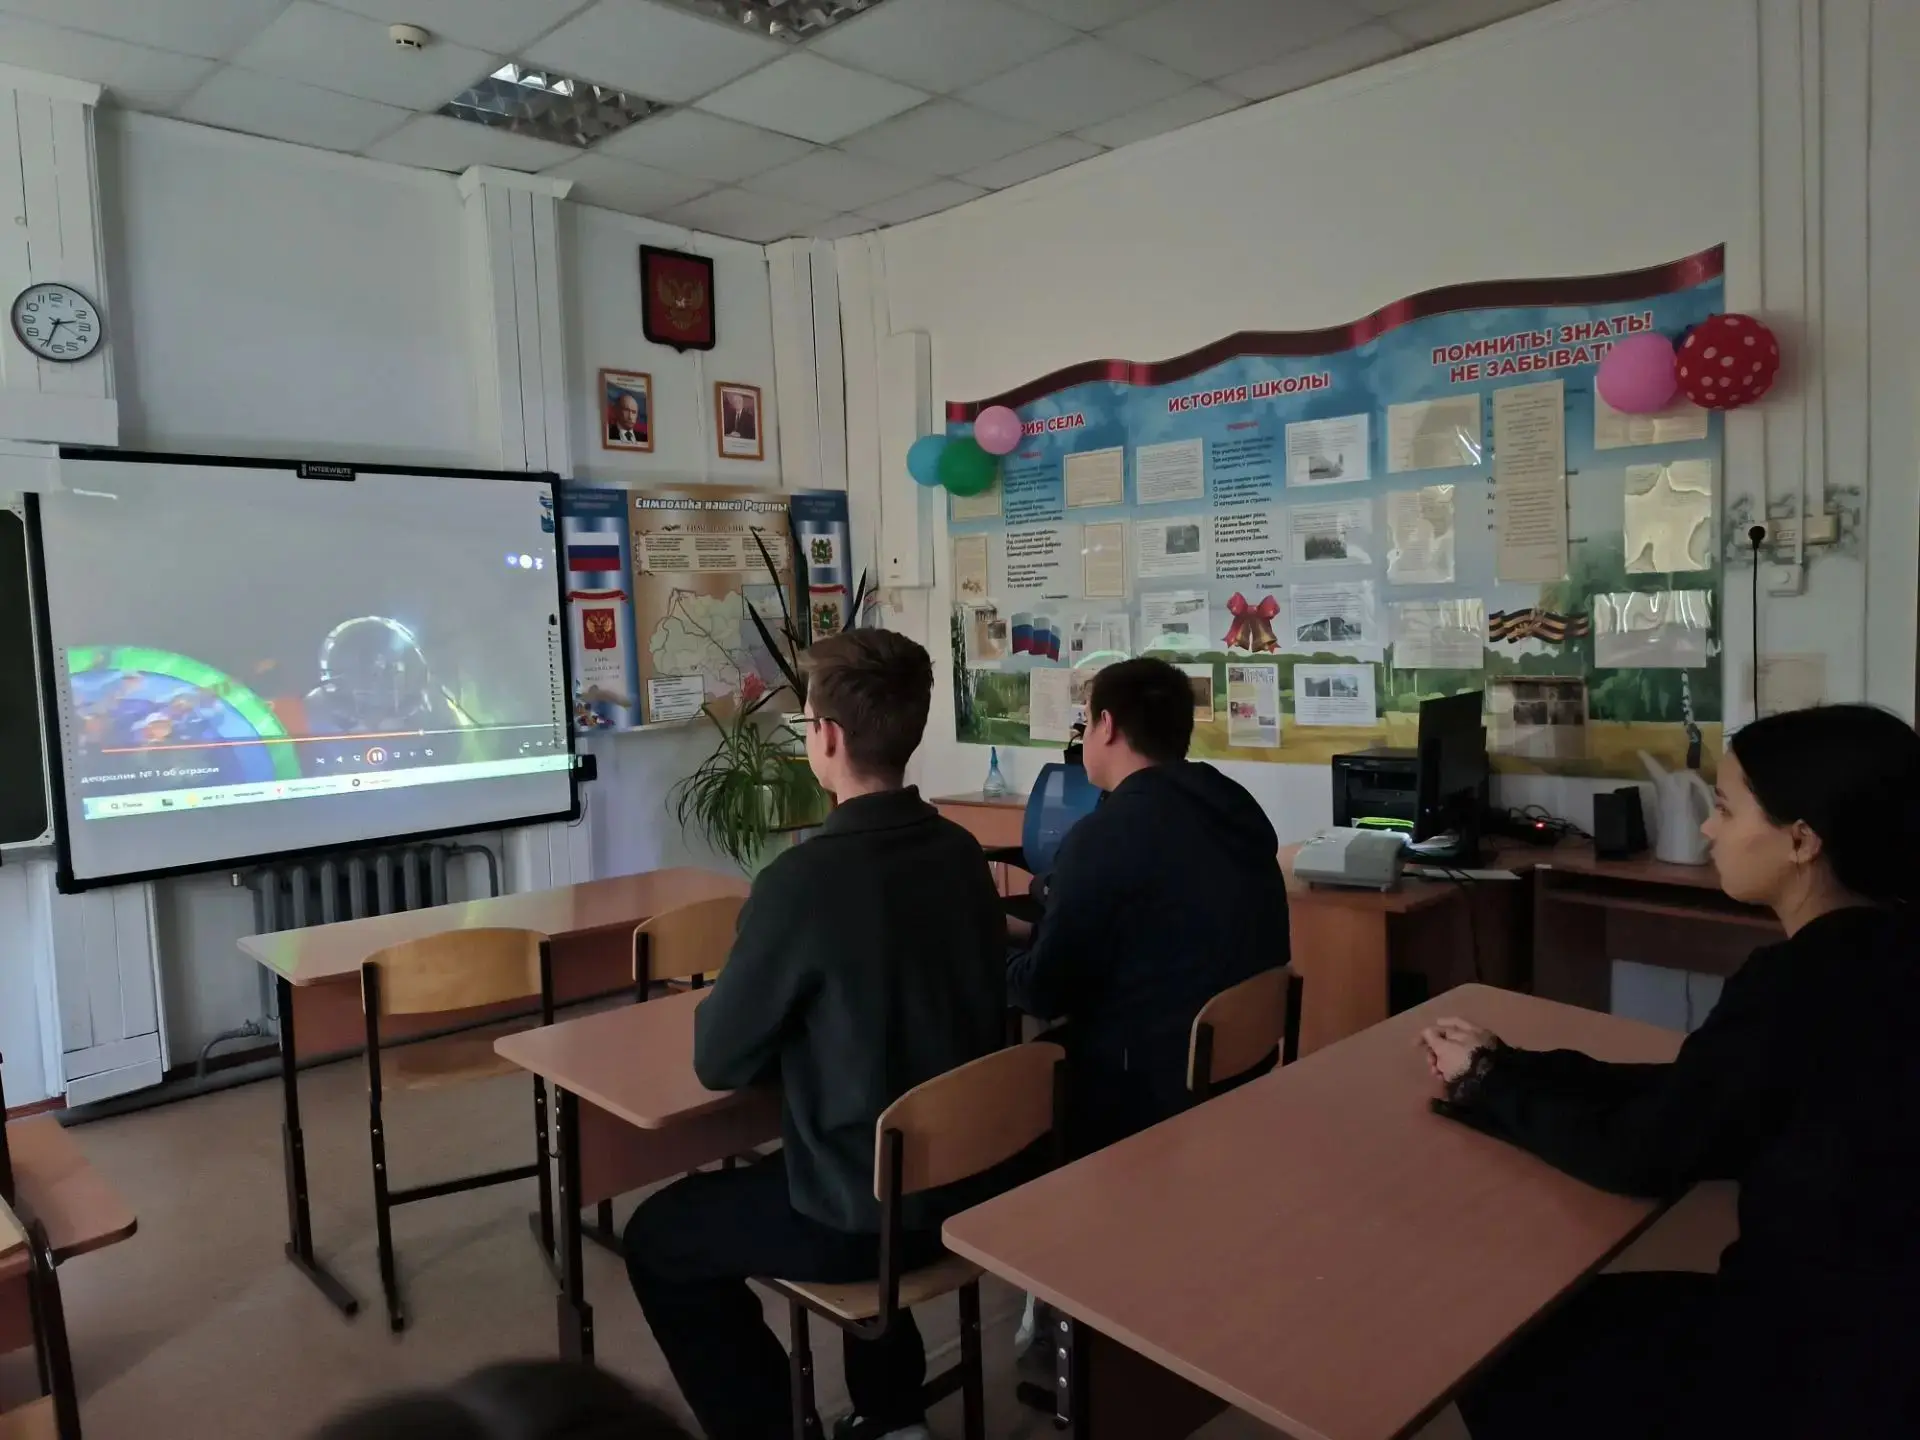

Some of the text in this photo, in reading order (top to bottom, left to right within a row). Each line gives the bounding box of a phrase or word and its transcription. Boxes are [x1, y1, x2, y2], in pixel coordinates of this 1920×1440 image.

[38, 295, 45, 303] 11
[48, 292, 63, 303] 12
[26, 301, 39, 312] 10
[69, 299, 73, 308] 1
[22, 314, 36, 324] 9
[76, 310, 87, 320] 2
[27, 327, 39, 337] 8
[78, 322, 91, 333] 3
[38, 338, 49, 348] 7
[76, 335, 88, 344] 4
[1432, 311, 1652, 366] ПОМНИТЬ! ЗНАТЬ!
[52, 344, 65, 354] 6
[66, 341, 79, 352] 5
[1450, 363, 1480, 383] НЕ
[1168, 371, 1331, 413] ИСТОРИЯ ШКОЛЫ
[1048, 412, 1085, 432] СЕЛА
[635, 497, 702, 510] Символика
[705, 500, 741, 511] нашей
[744, 499, 788, 513] Родины
